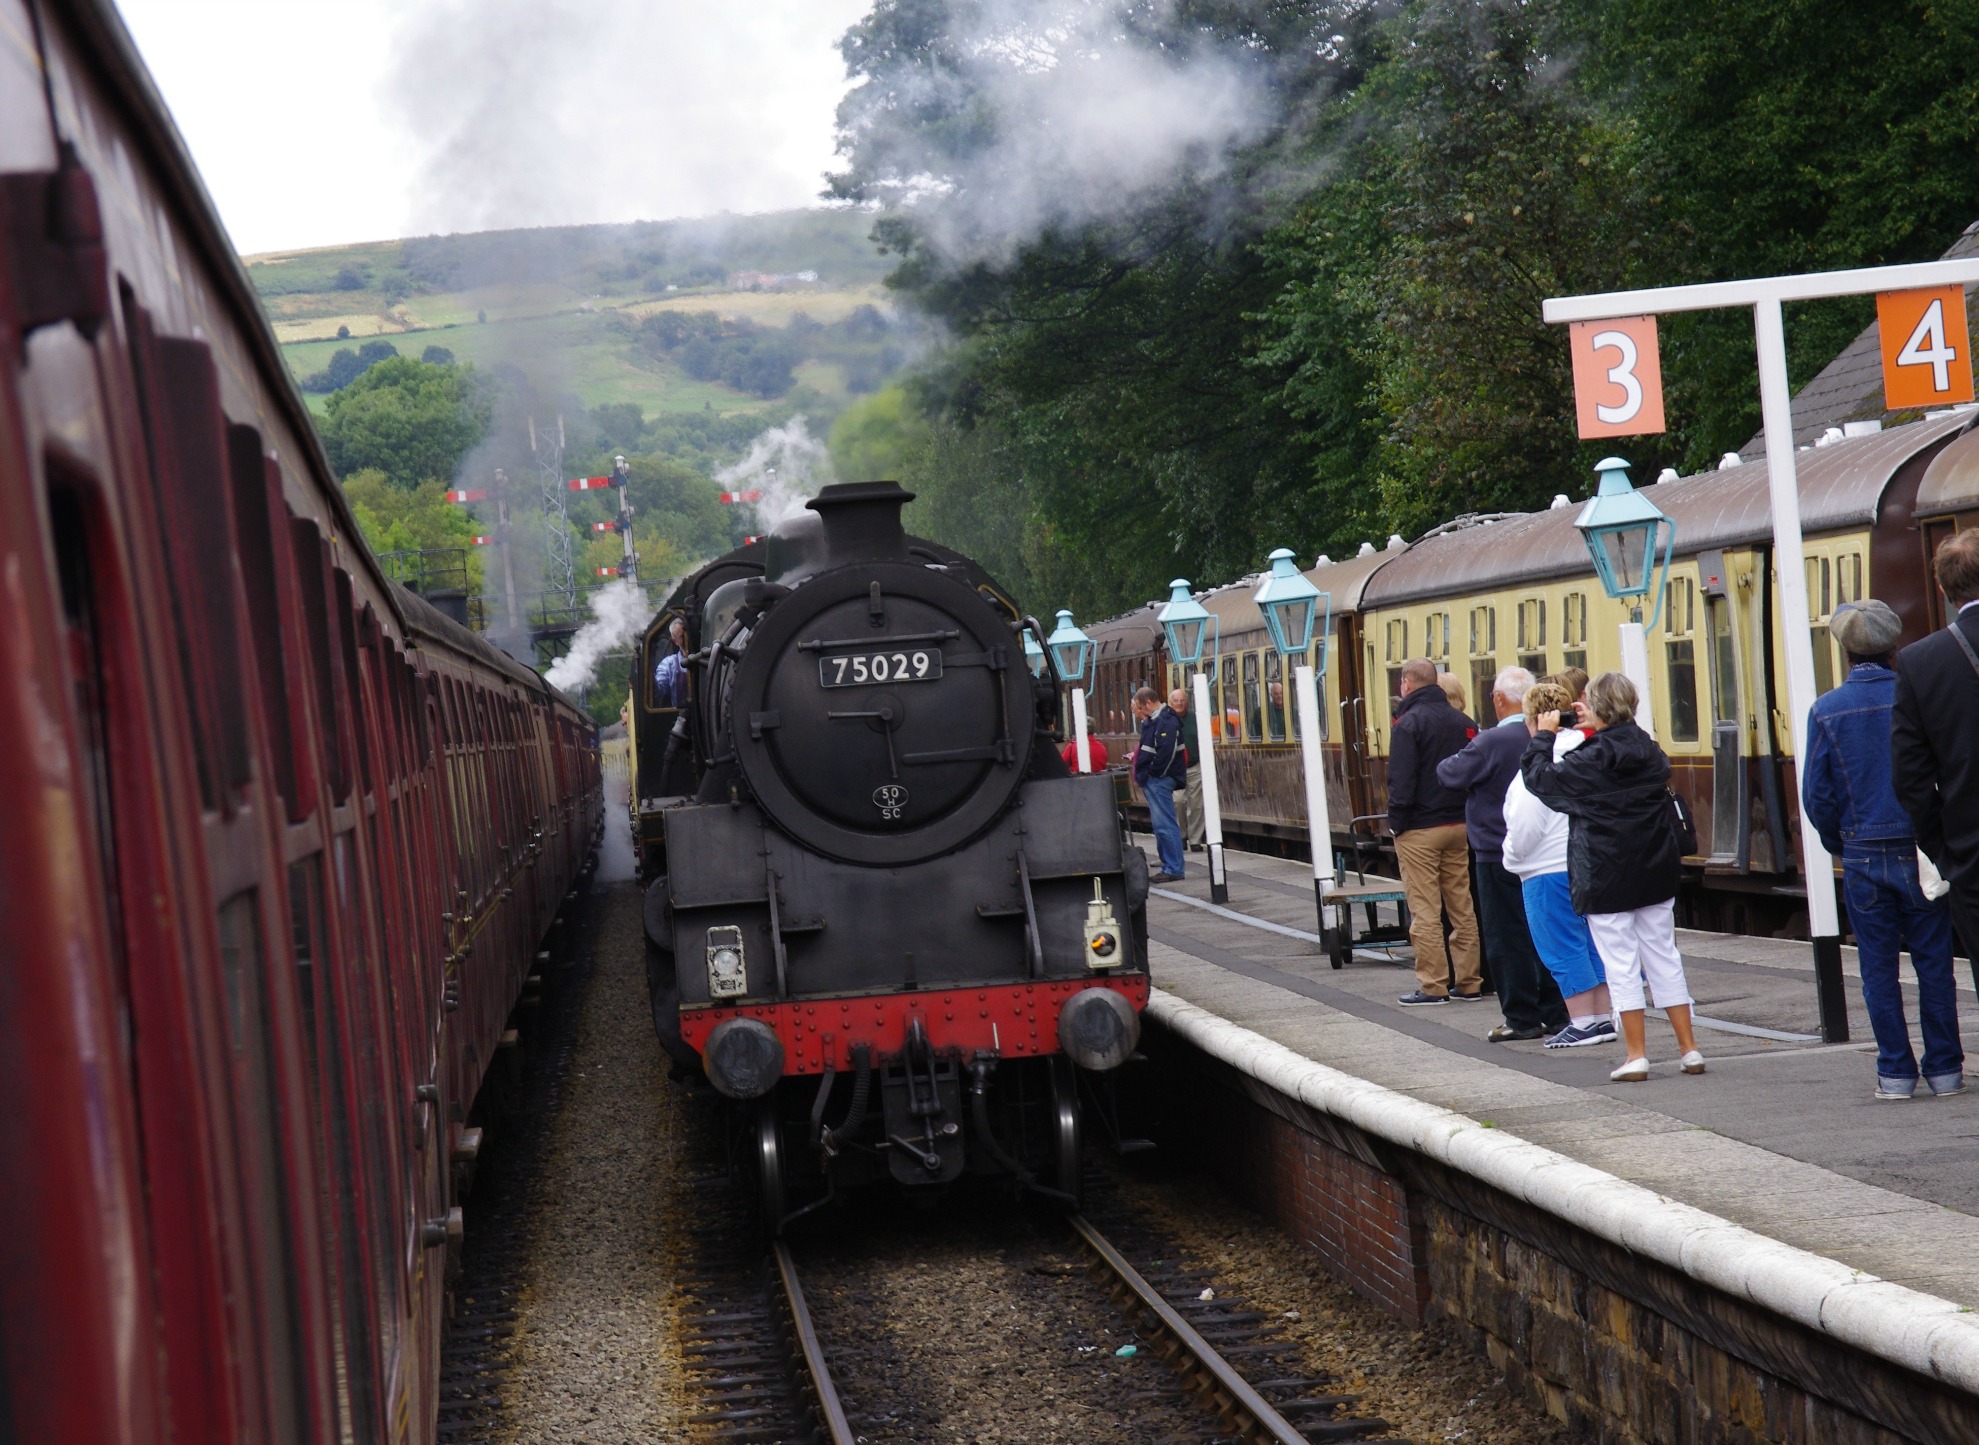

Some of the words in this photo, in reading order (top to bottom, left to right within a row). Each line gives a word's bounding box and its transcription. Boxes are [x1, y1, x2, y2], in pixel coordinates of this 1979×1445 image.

[1896, 298, 1956, 393] 4
[1592, 330, 1643, 425] 3
[832, 652, 929, 684] 75029
[882, 787, 899, 799] 50
[887, 798, 896, 806] H
[882, 808, 901, 819] SC
